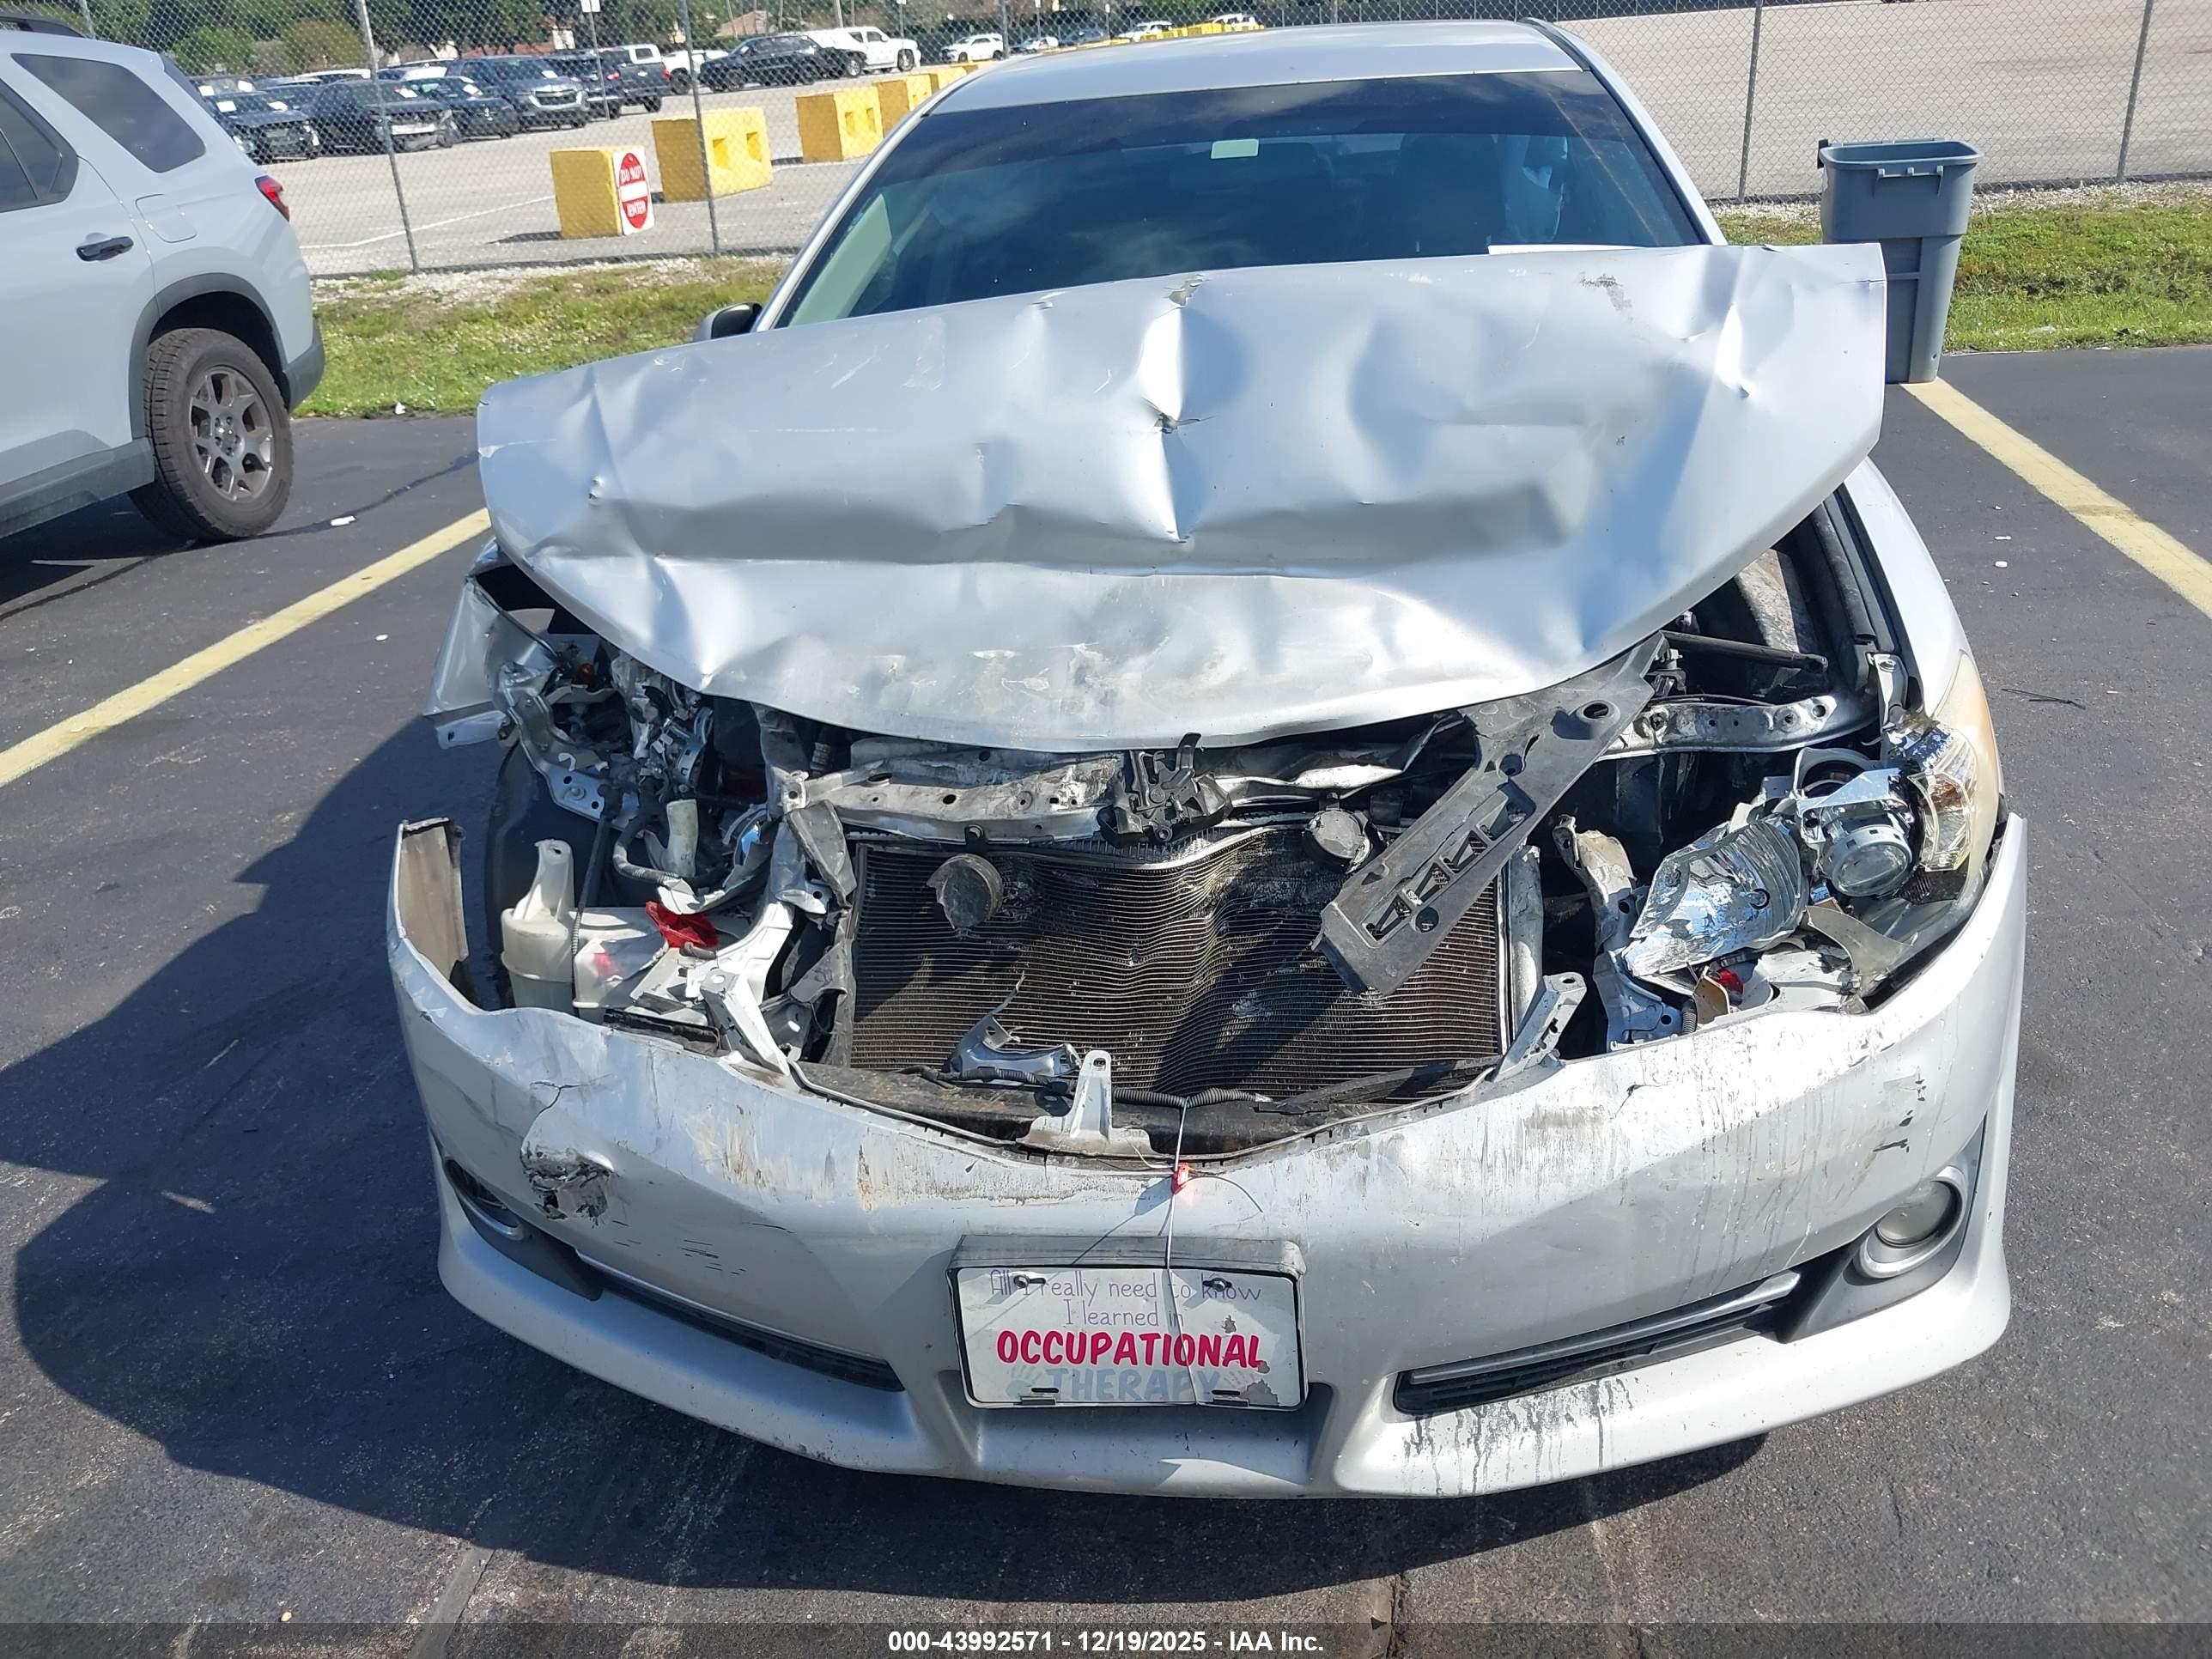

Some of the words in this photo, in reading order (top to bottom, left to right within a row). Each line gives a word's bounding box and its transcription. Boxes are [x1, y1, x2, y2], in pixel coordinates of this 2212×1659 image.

[990, 1269, 1012, 1296] All
[1039, 1271, 1098, 1307] really
[1109, 1272, 1158, 1298] need
[1064, 1298, 1074, 1325] I
[1082, 1300, 1159, 1327] learned
[1169, 1311, 1184, 1327] in
[997, 1330, 1261, 1368] OCCUPATIONAL
[1045, 1366, 1221, 1401] THERAPY
